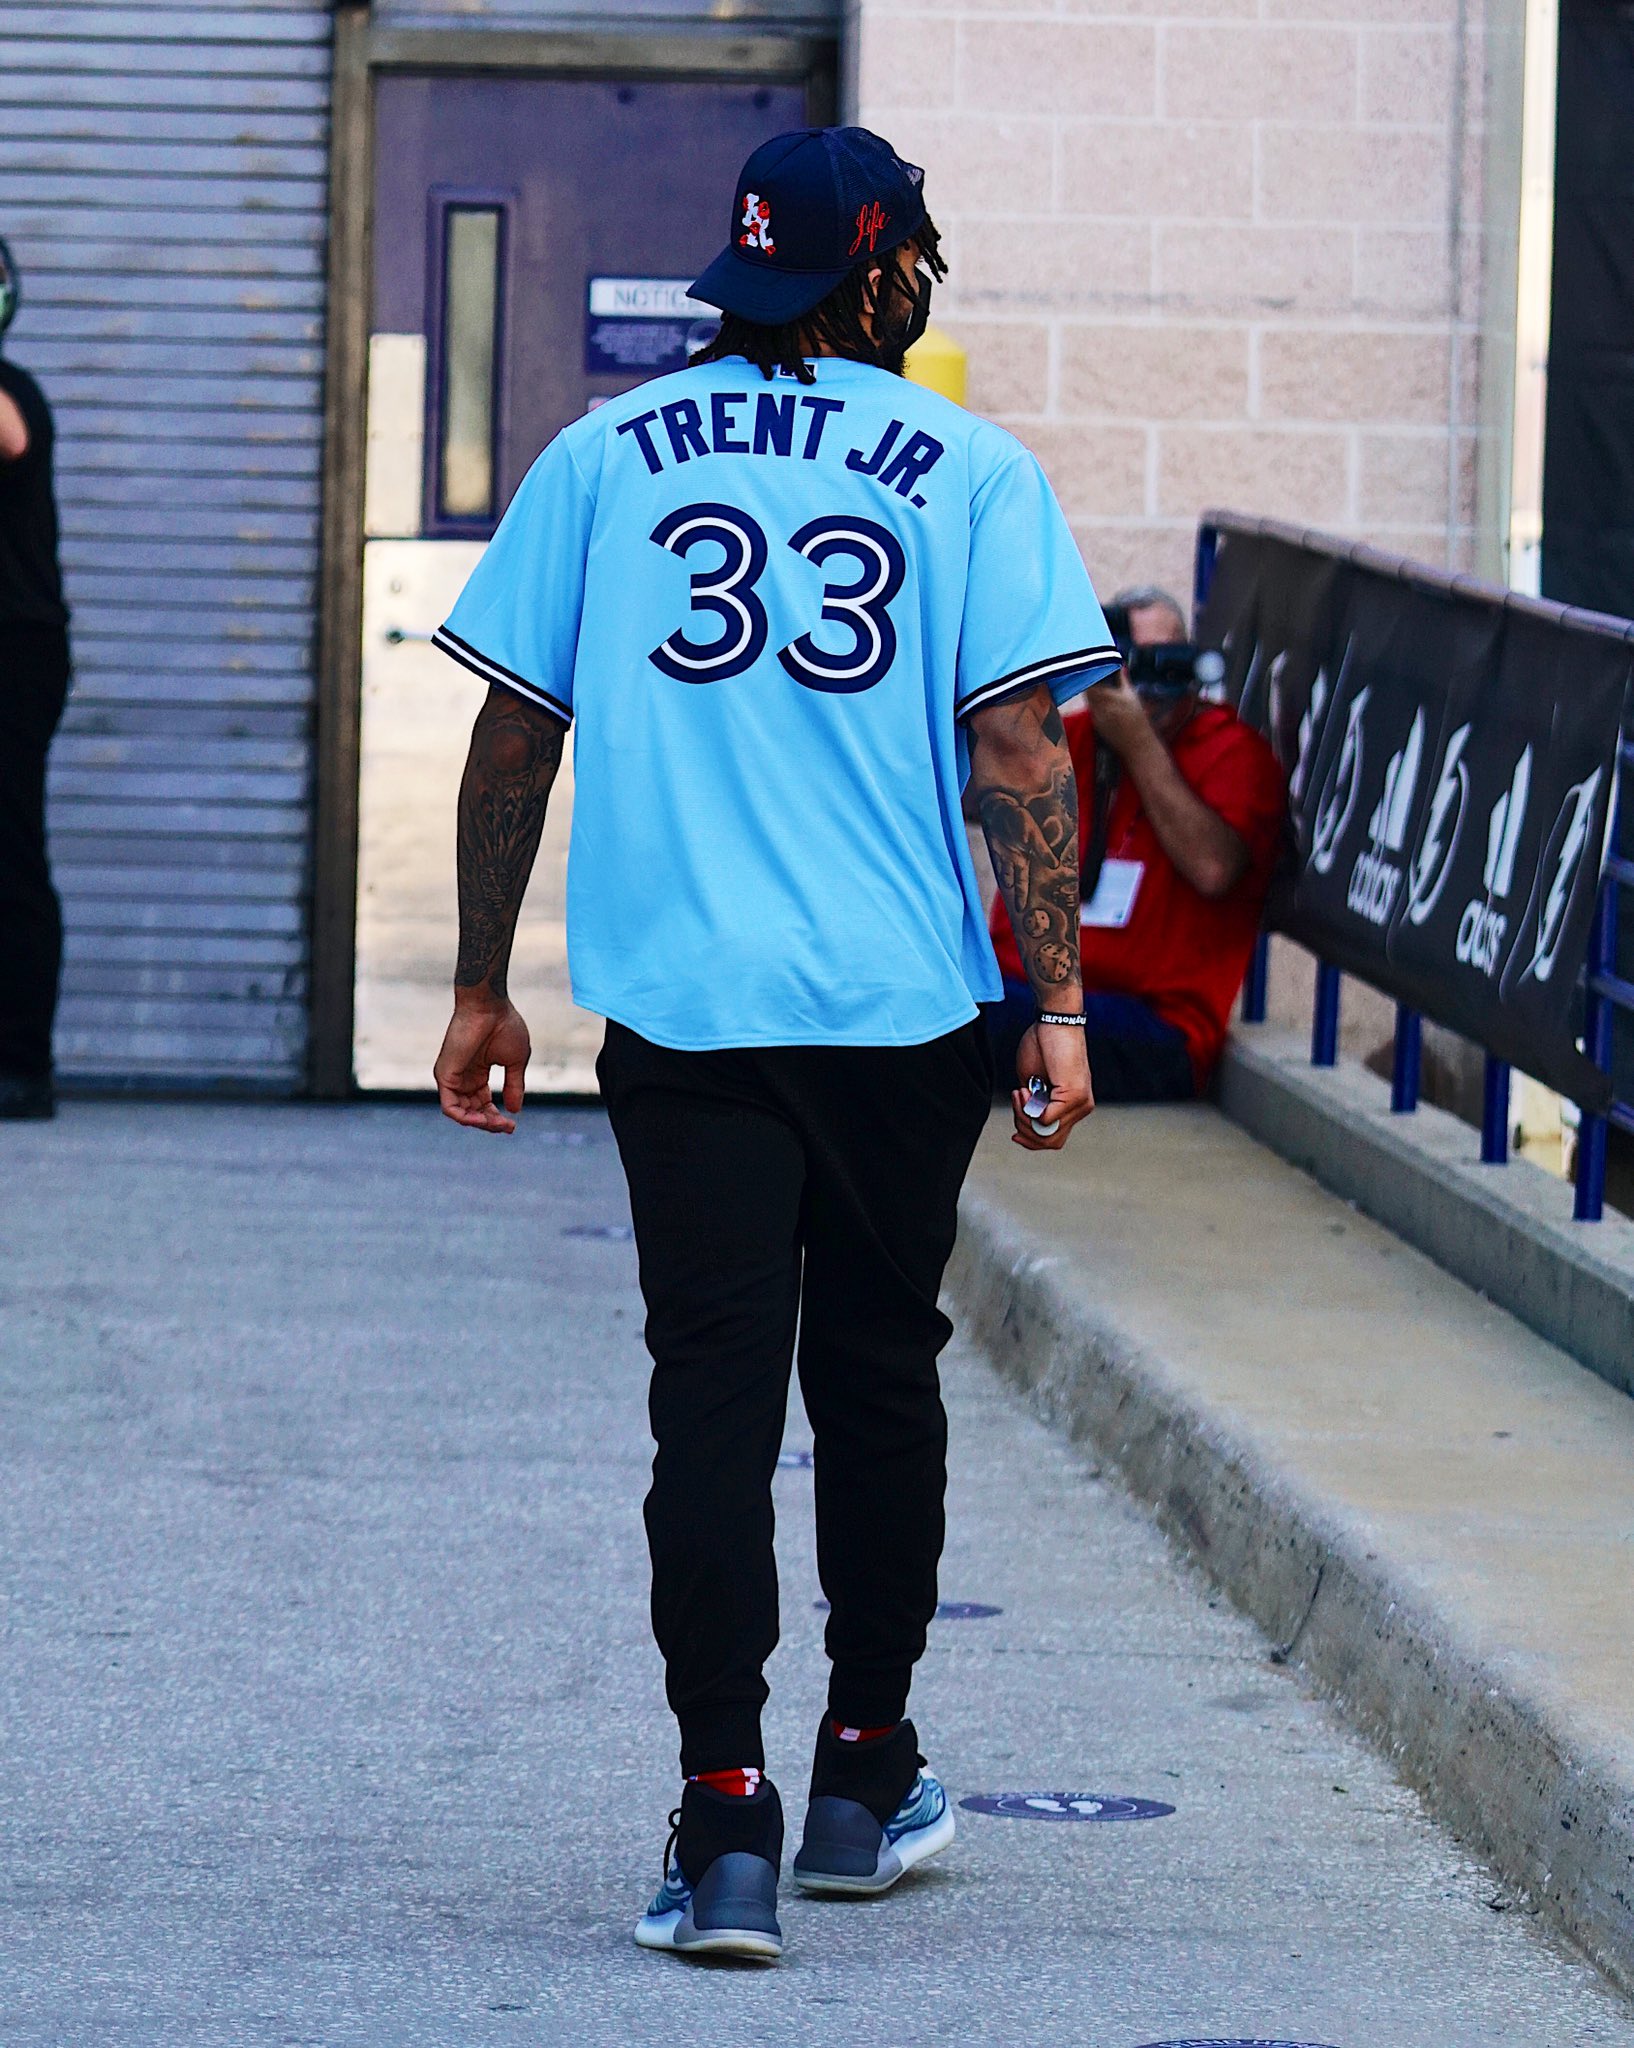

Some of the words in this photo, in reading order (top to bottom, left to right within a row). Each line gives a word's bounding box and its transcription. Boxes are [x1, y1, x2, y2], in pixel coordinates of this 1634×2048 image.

[849, 201, 891, 255] Life
[616, 393, 845, 475] TRENT
[845, 419, 944, 509] JR.
[648, 502, 906, 694] 33
